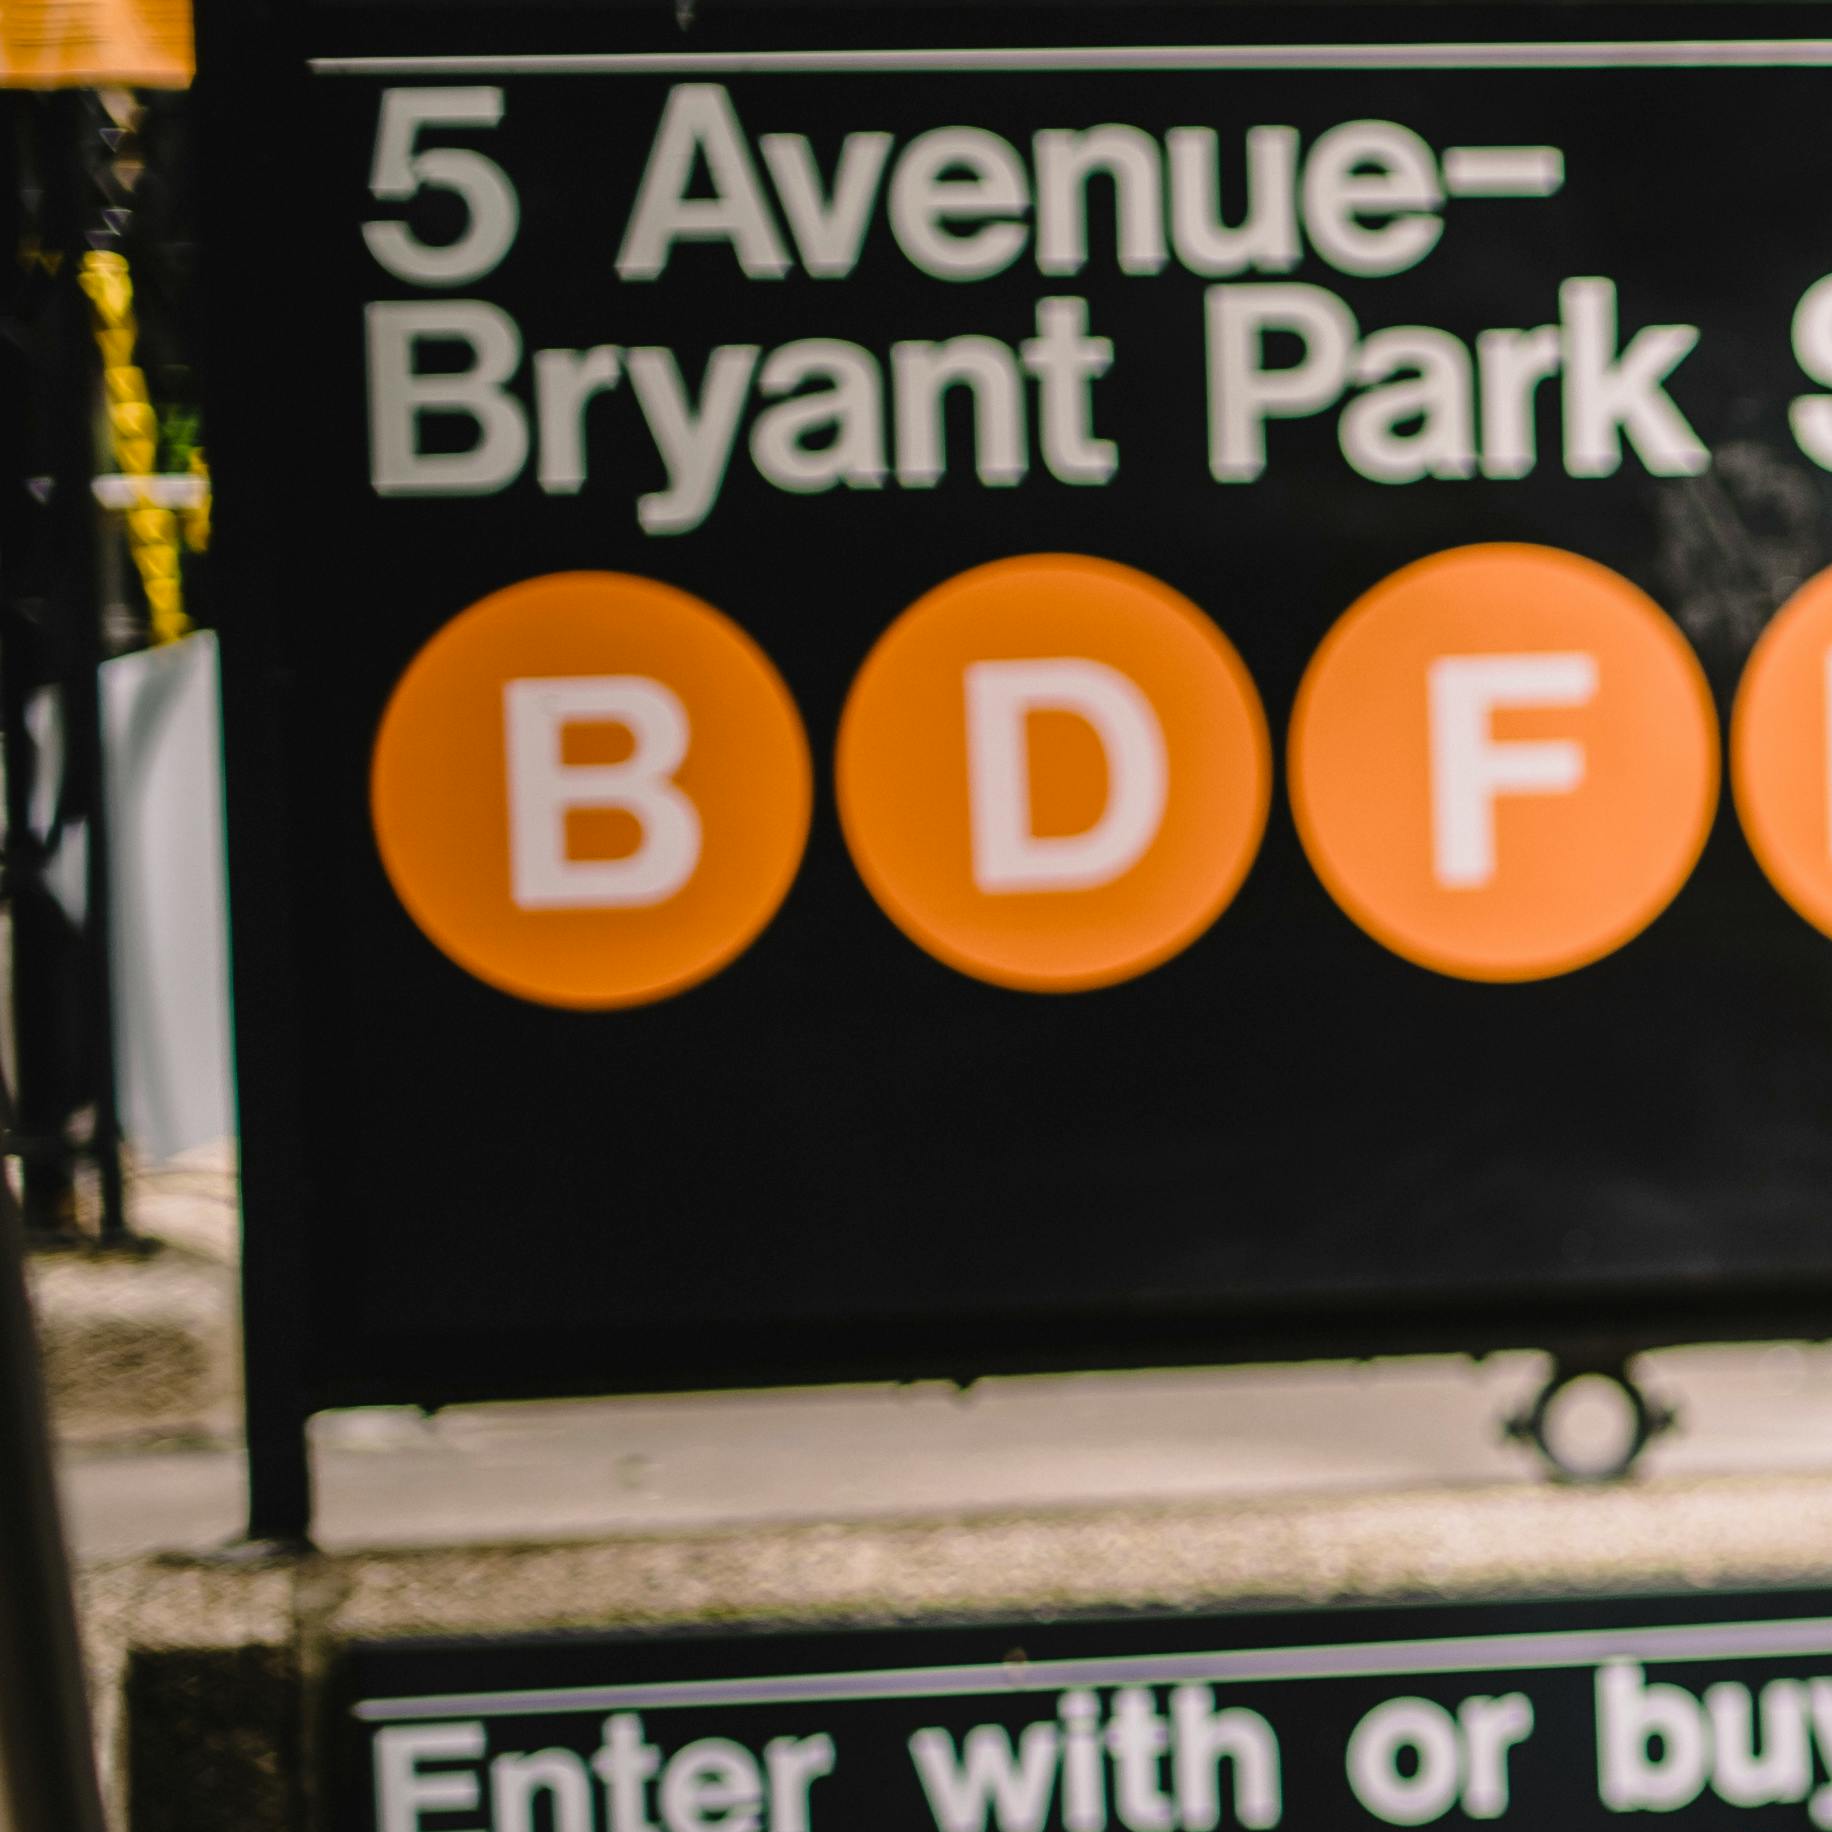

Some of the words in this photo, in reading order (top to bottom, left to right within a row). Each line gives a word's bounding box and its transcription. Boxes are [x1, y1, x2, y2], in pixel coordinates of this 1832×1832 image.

[365, 84, 517, 282] 5
[366, 297, 1119, 531] Bryant
[1203, 276, 1713, 486] Park
[506, 675, 702, 908] B
[963, 657, 1170, 892] D
[1425, 652, 1600, 886] F
[1344, 1692, 1536, 1827] or
